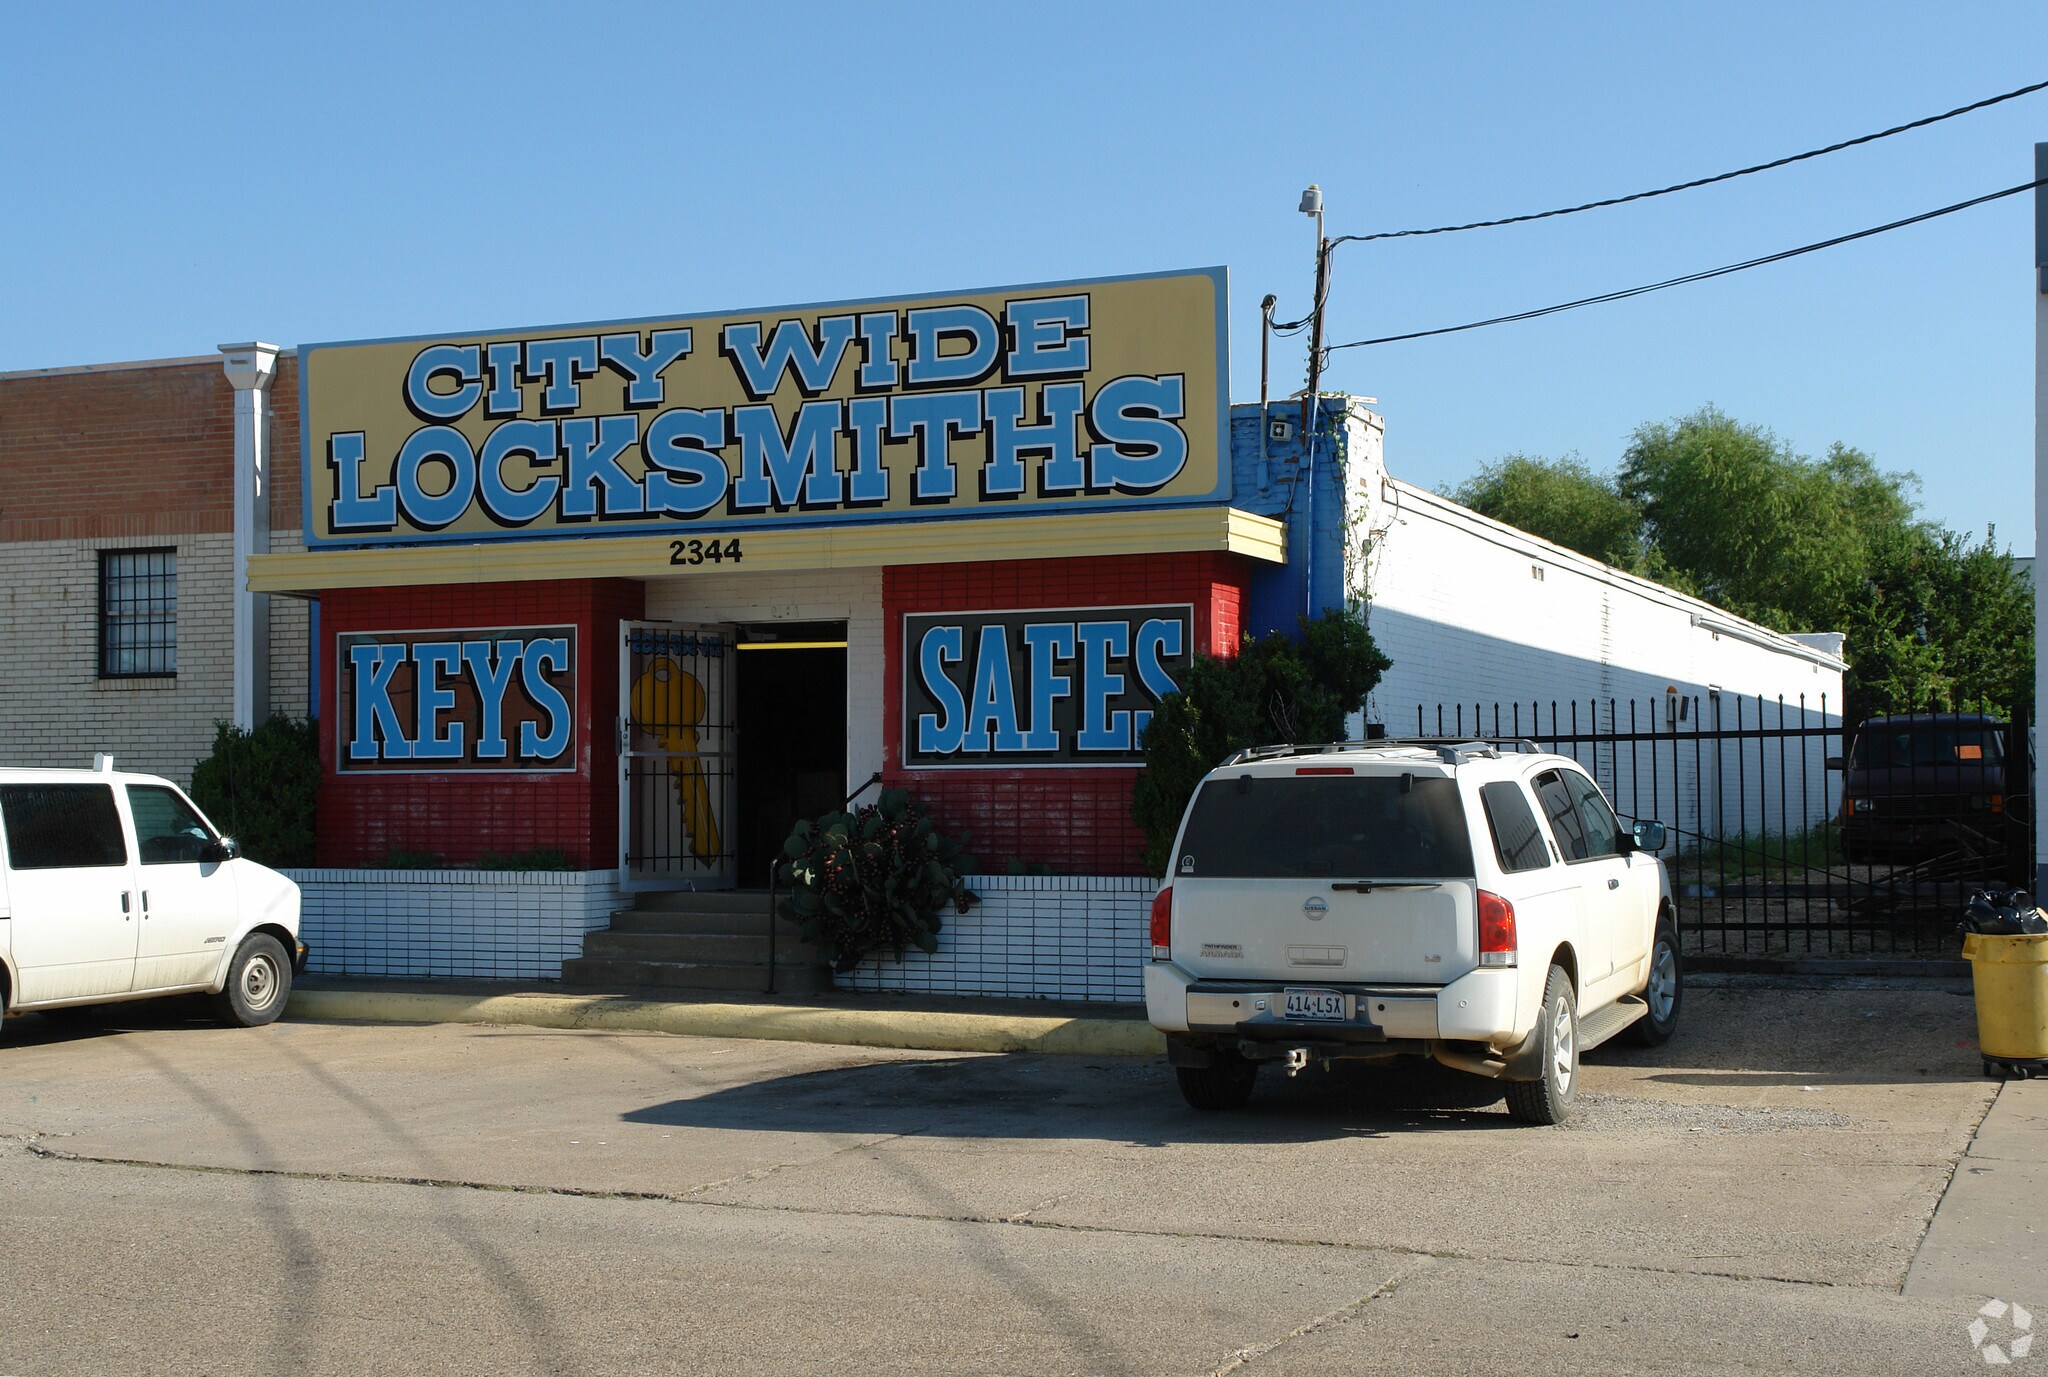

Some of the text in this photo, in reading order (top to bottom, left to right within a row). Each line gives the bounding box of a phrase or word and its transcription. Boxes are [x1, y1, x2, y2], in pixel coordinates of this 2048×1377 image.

[404, 293, 1091, 424] CITY WIDE
[327, 373, 1189, 534] LOCKSMITHS
[669, 538, 743, 565] 2344
[346, 637, 572, 762] KEYS
